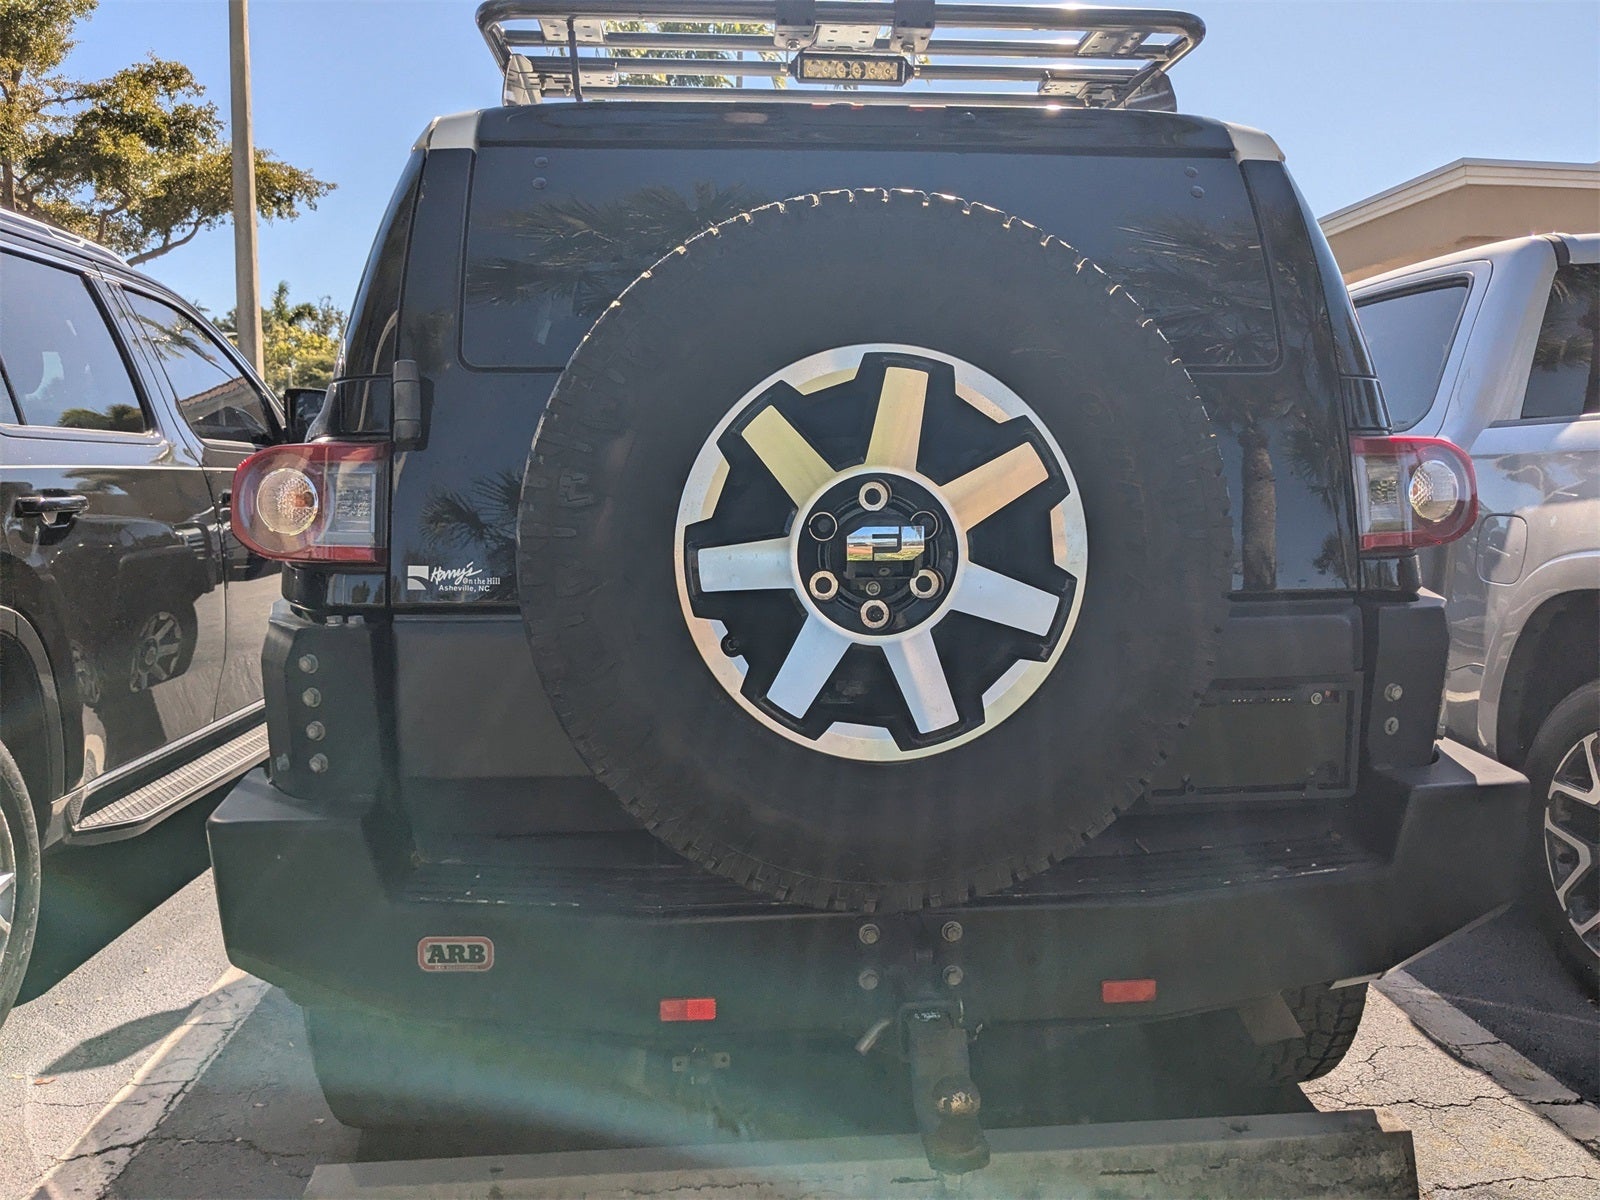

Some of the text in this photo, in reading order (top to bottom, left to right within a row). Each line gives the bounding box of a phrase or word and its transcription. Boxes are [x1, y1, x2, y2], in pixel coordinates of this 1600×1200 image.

[430, 561, 483, 585] Harry's
[438, 584, 477, 592] Asheville,
[474, 577, 486, 585] the
[486, 577, 500, 585] Hill
[427, 944, 486, 964] ARB
